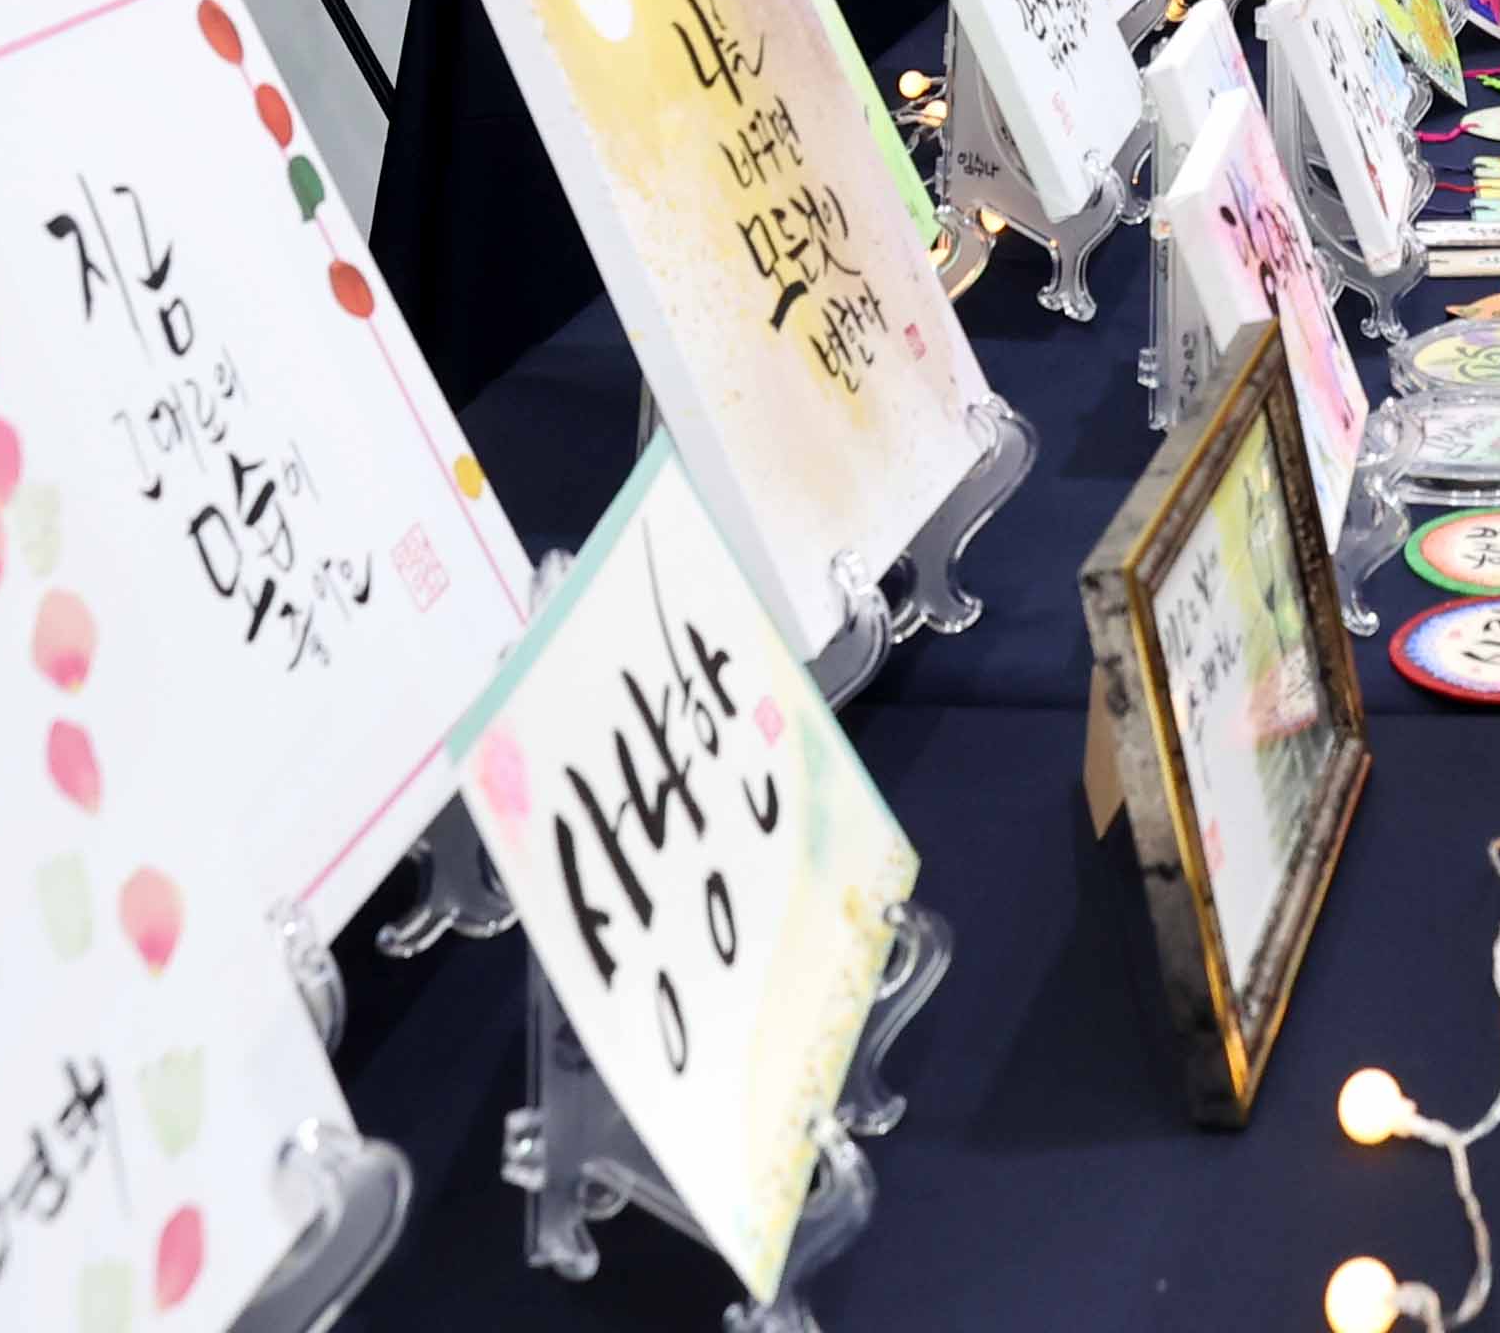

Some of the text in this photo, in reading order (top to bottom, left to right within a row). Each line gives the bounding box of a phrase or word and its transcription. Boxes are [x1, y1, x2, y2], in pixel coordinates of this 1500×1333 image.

[719, 94, 805, 190] 바꾸면
[957, 151, 1001, 180] 임수나
[44, 171, 198, 361] 지금
[809, 278, 890, 396] 변한다
[111, 341, 248, 504] 그대로의
[186, 441, 325, 646] 모습이
[275, 549, 379, 674] 좋아요
